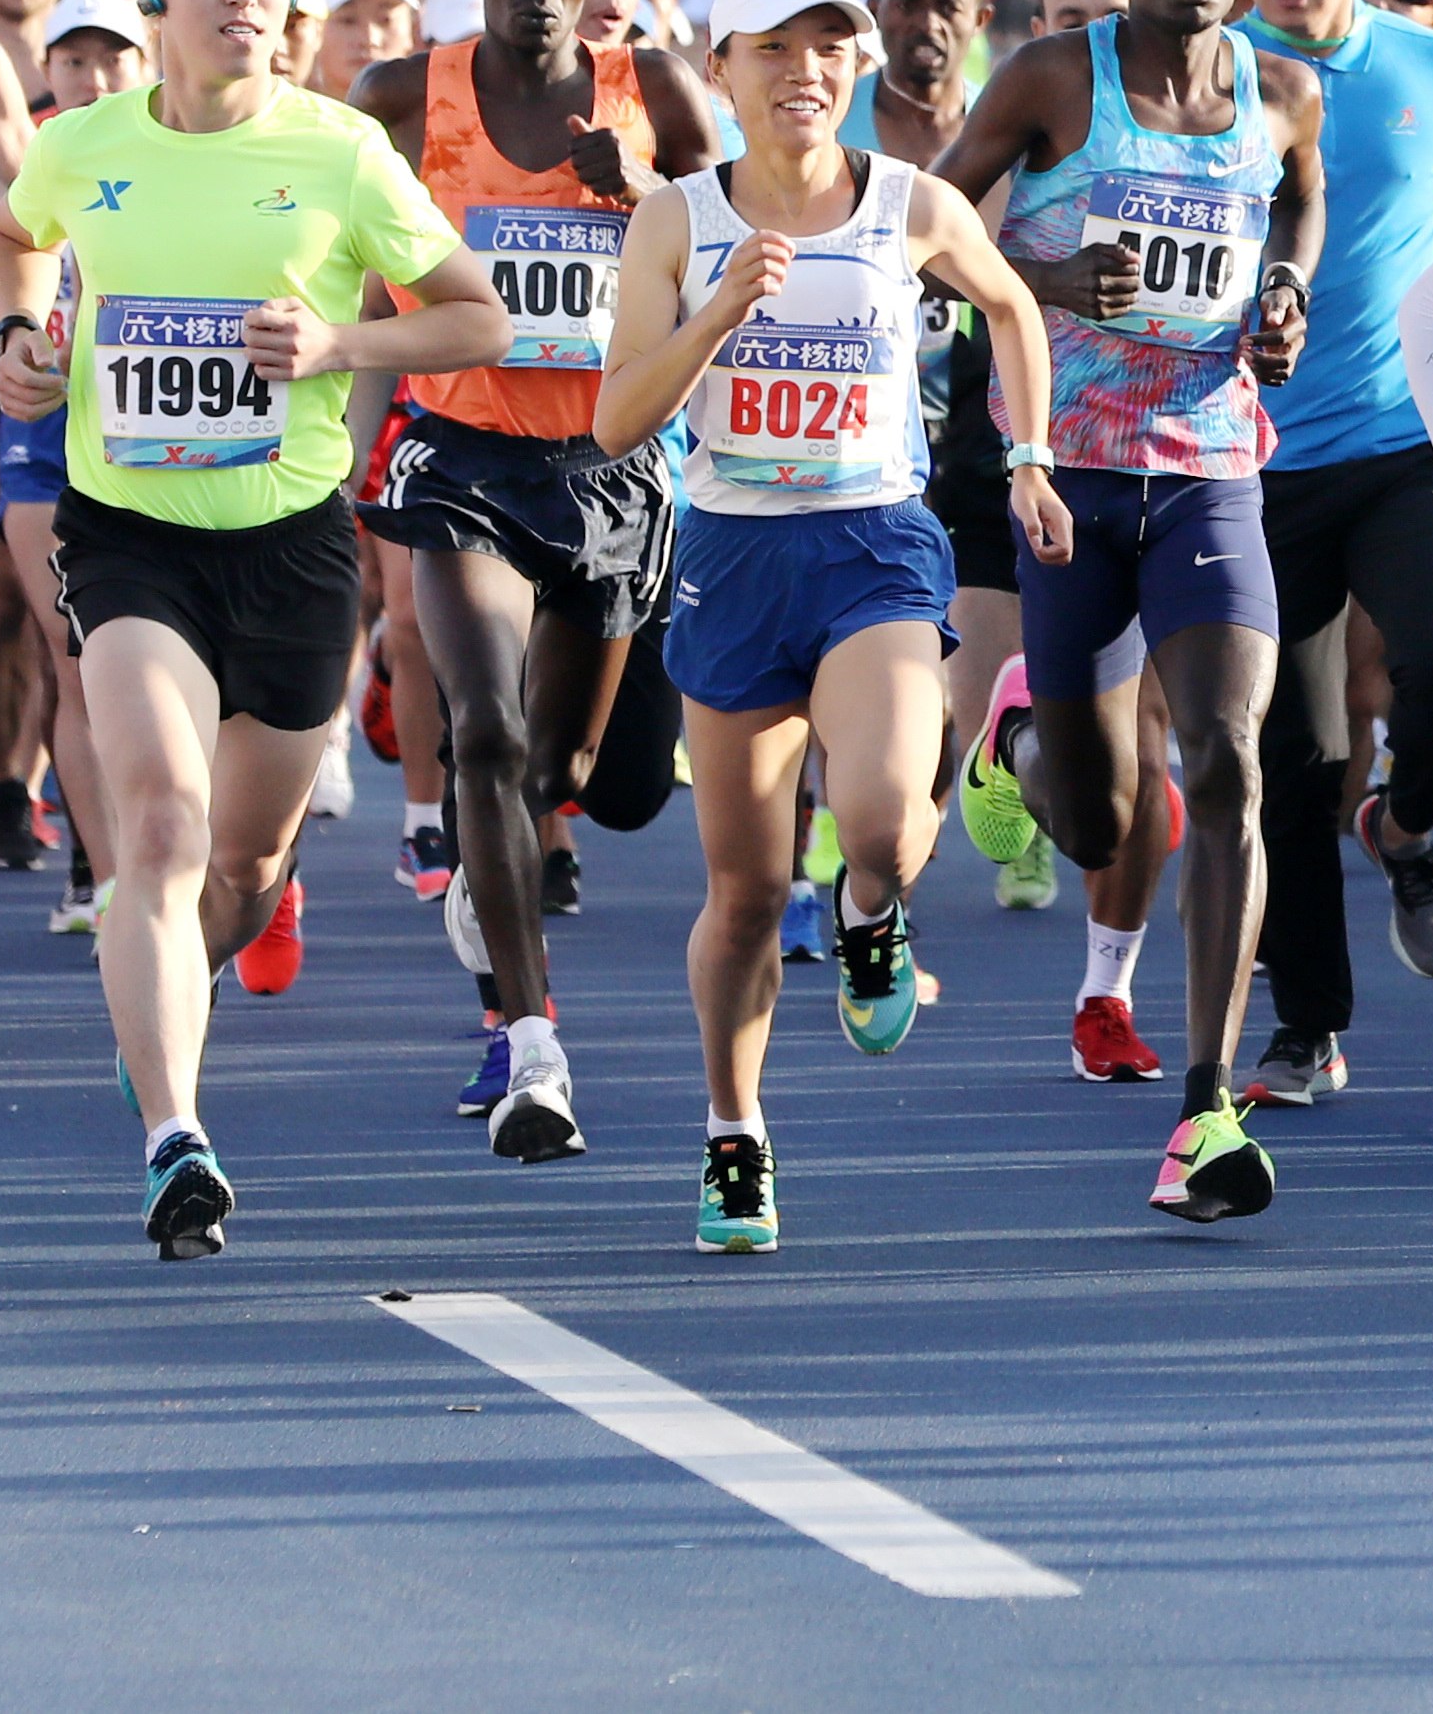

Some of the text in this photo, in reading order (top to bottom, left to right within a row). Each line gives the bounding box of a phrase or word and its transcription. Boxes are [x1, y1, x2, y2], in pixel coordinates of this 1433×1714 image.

[1124, 192, 1240, 232] 六个核桃
[499, 221, 617, 253] 六个核桃
[125, 314, 246, 346] 六个核桃
[738, 340, 865, 371] 六个核桃
[107, 355, 272, 418] 11994
[730, 376, 868, 441] B024
